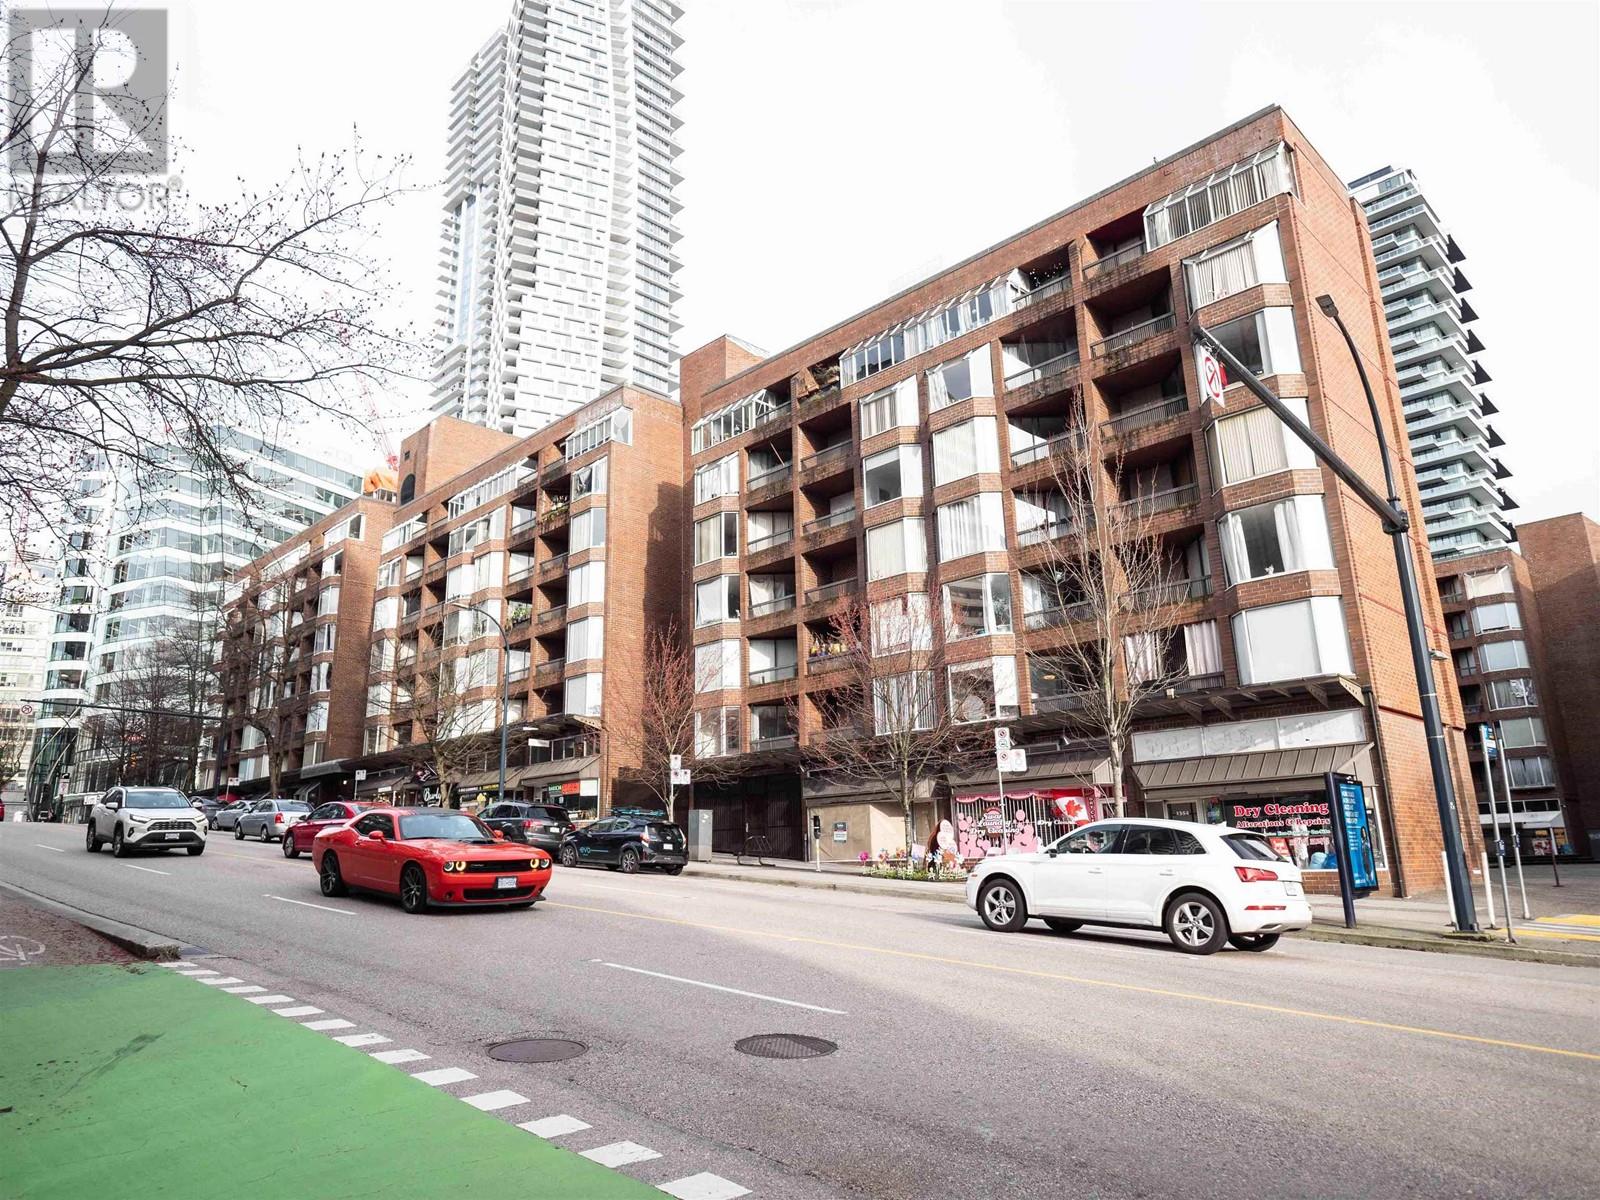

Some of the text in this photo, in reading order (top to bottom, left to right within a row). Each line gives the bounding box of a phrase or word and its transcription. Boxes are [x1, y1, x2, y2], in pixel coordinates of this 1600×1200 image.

[1234, 802, 1329, 818] Dry Cleaning
[977, 819, 1012, 829] Laundy
[1236, 819, 1285, 829] Alterations
[1296, 816, 1331, 827] Repairs
